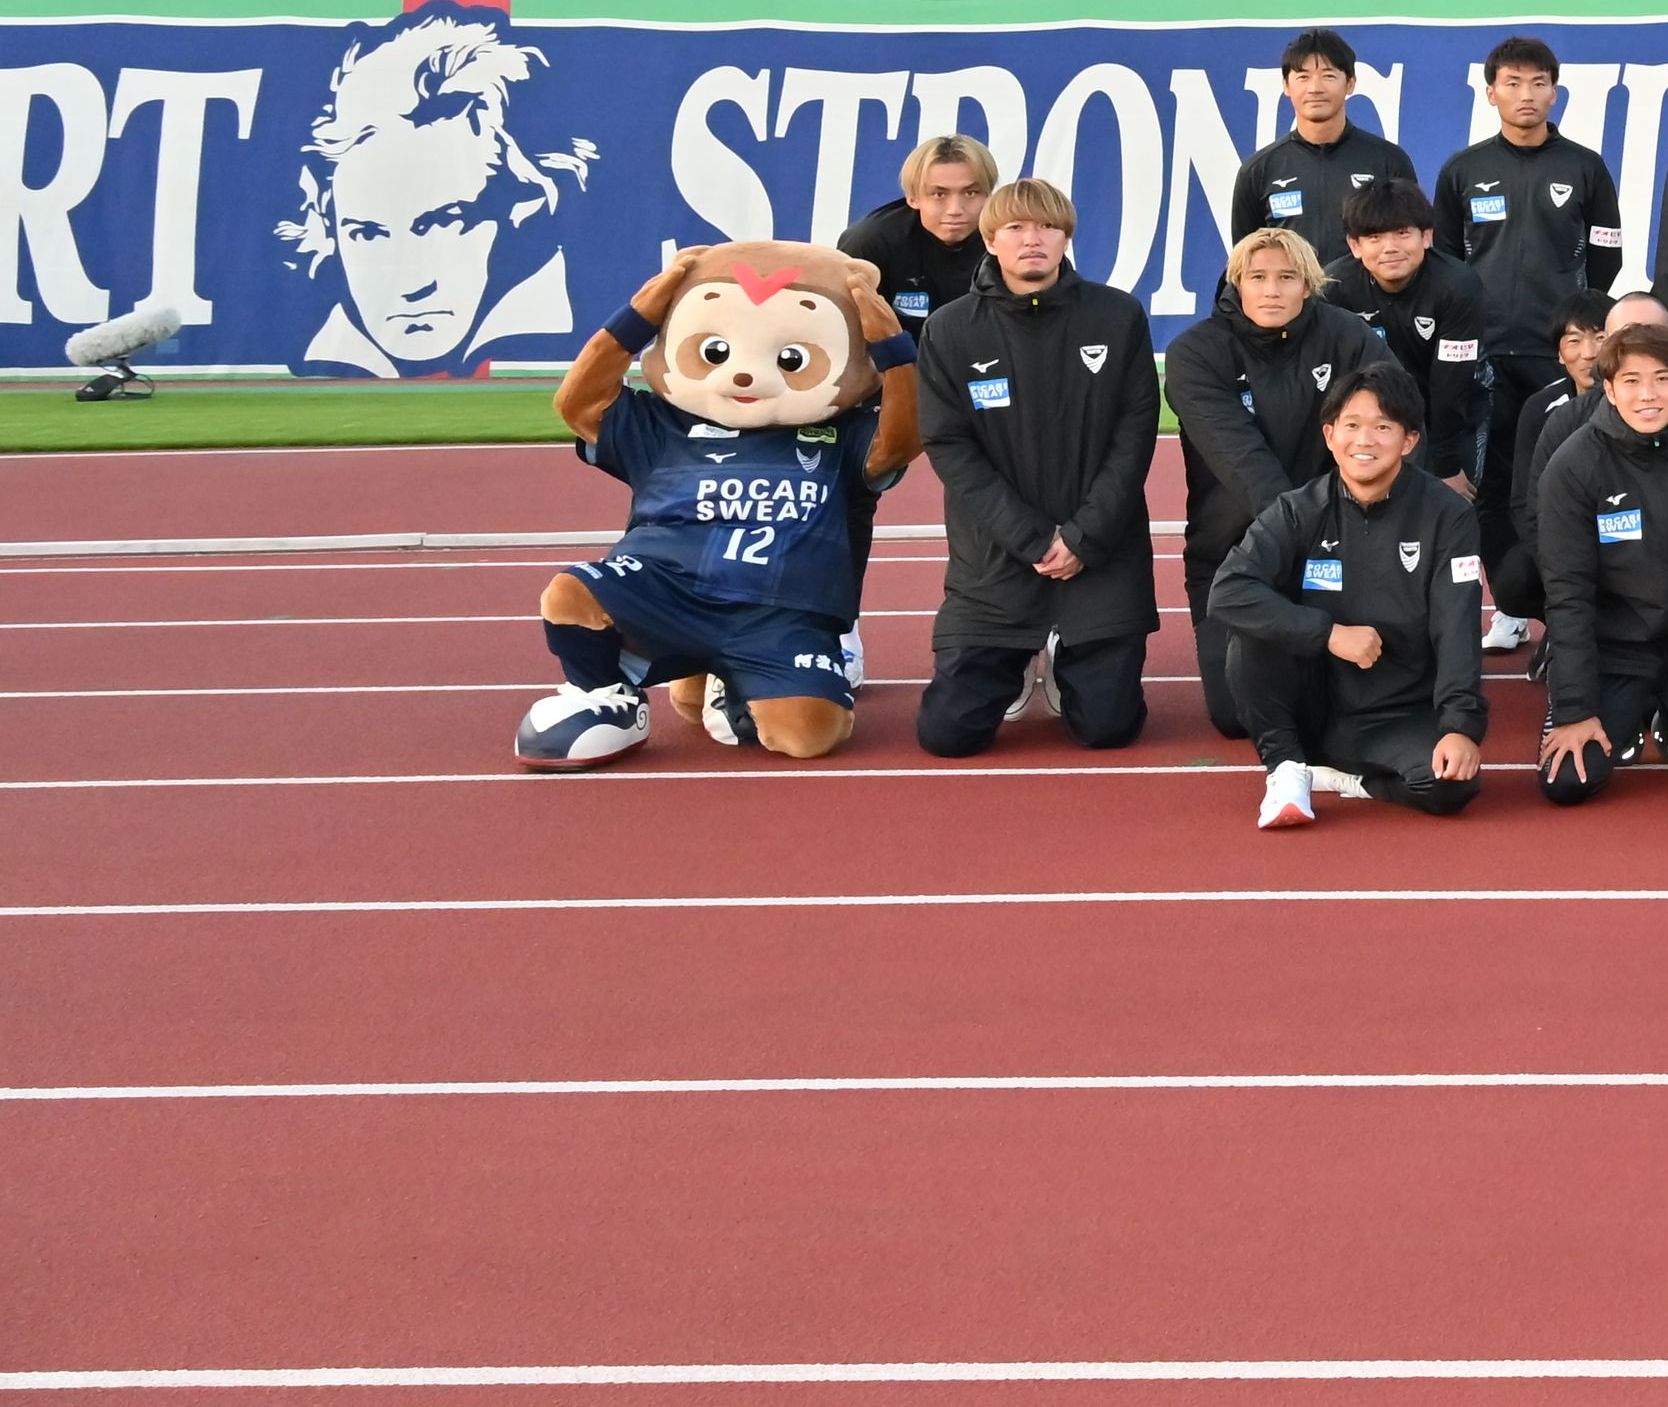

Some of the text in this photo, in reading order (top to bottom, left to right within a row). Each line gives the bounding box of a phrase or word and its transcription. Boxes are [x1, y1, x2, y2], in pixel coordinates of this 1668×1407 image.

[695, 478, 829, 503] POCARI
[696, 501, 816, 523] SWEAT
[722, 525, 776, 565] 12
